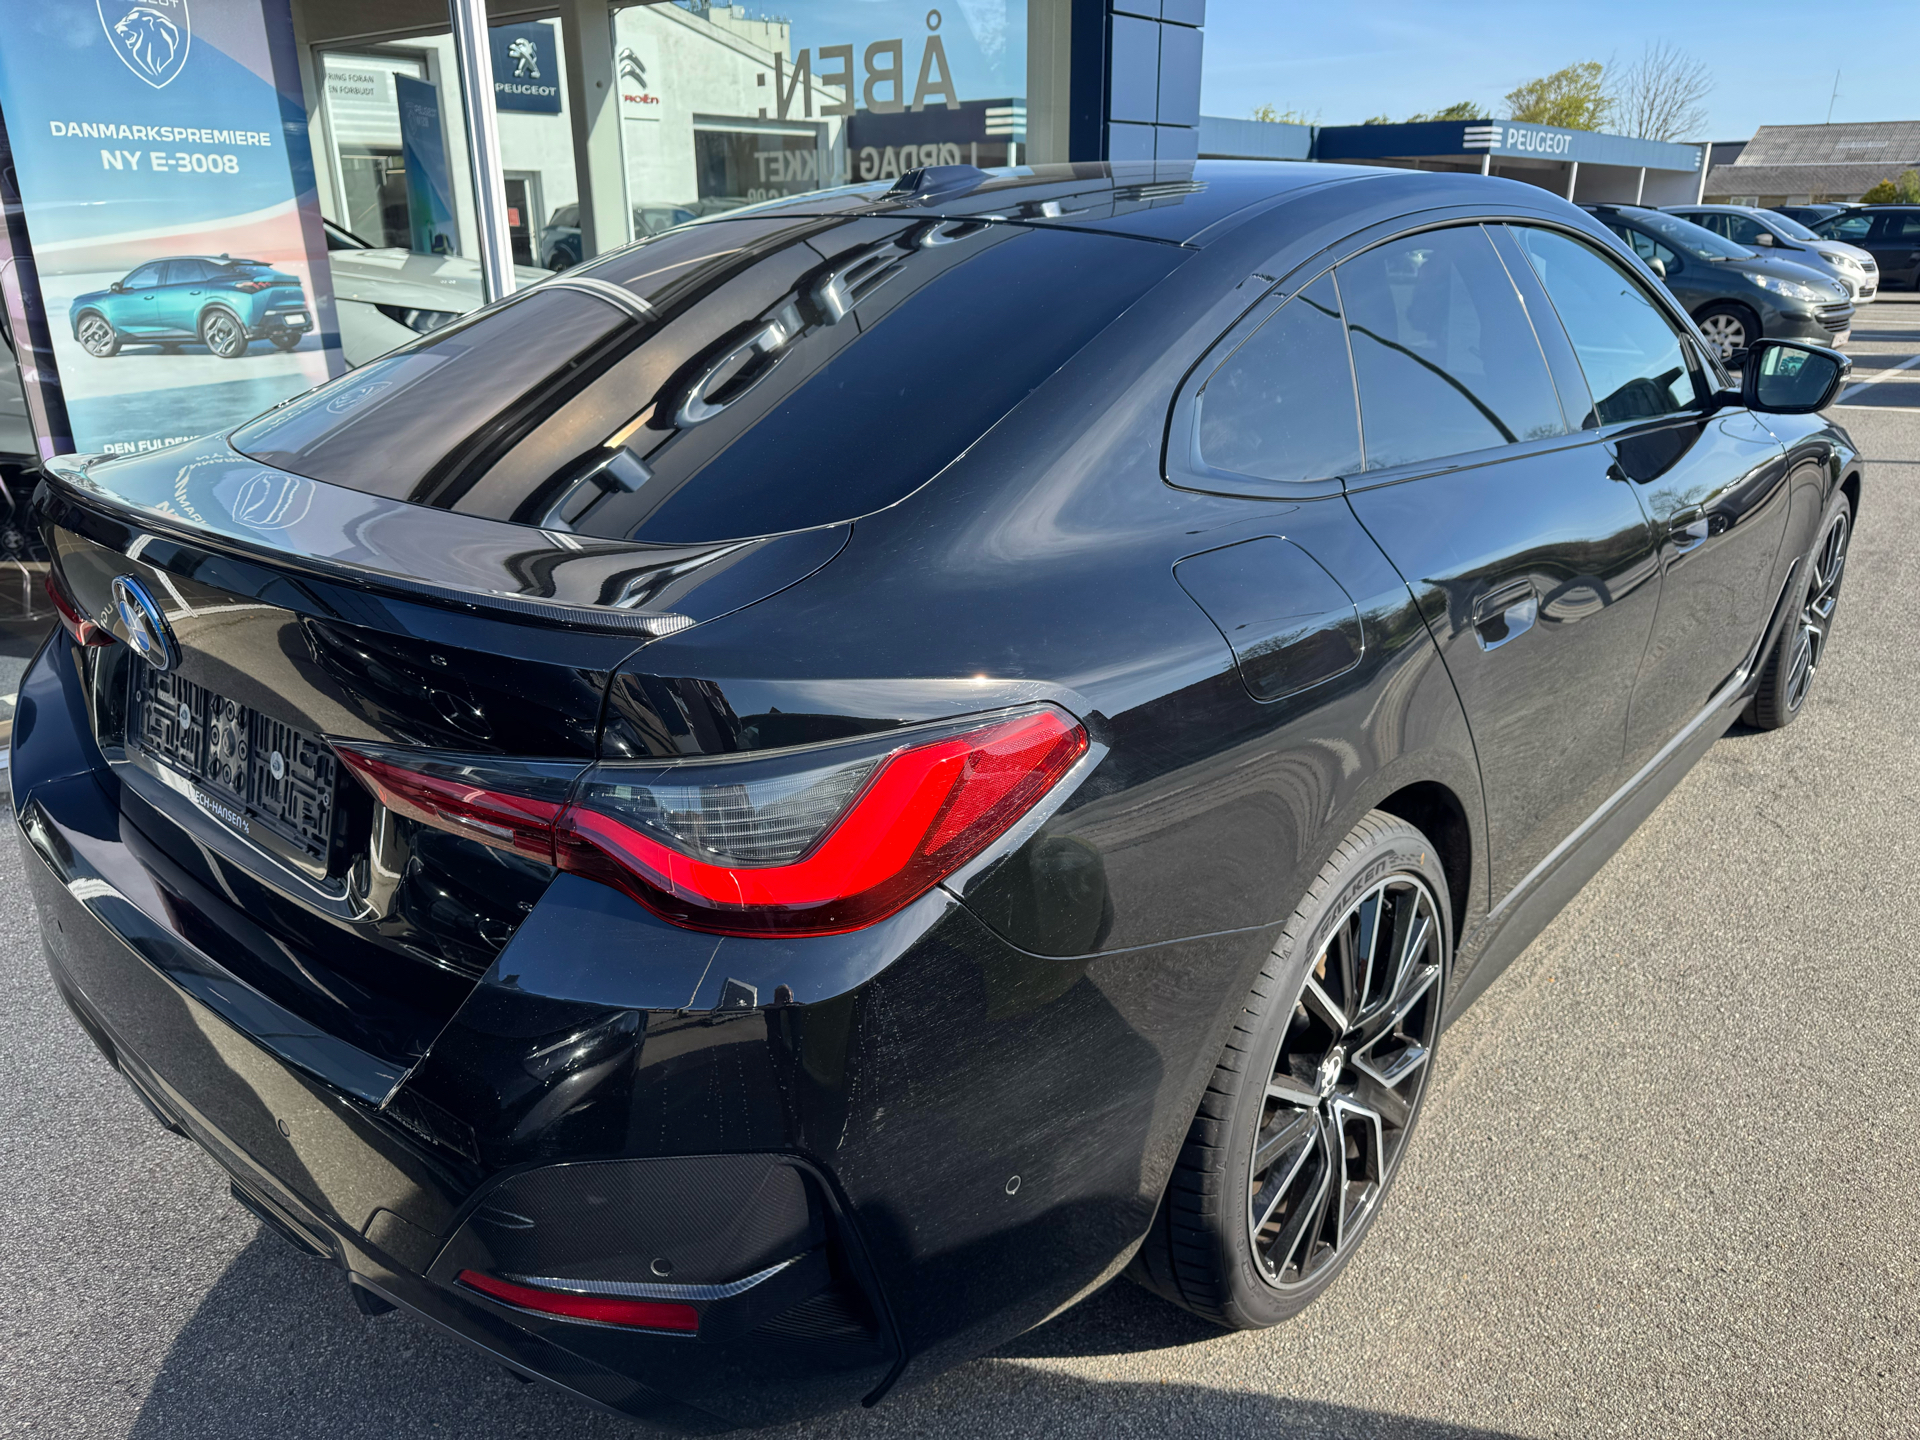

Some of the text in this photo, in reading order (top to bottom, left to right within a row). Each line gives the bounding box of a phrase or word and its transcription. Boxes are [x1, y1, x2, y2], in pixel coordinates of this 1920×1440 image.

[494, 82, 557, 96] PEUGEOT
[49, 121, 272, 147] DANMARKSPREMIERE
[1506, 127, 1573, 154] PEUGEOT
[100, 150, 240, 174] NY E-3008
[103, 441, 136, 454] DEN
[193, 787, 242, 829] ECH-HANSEN
